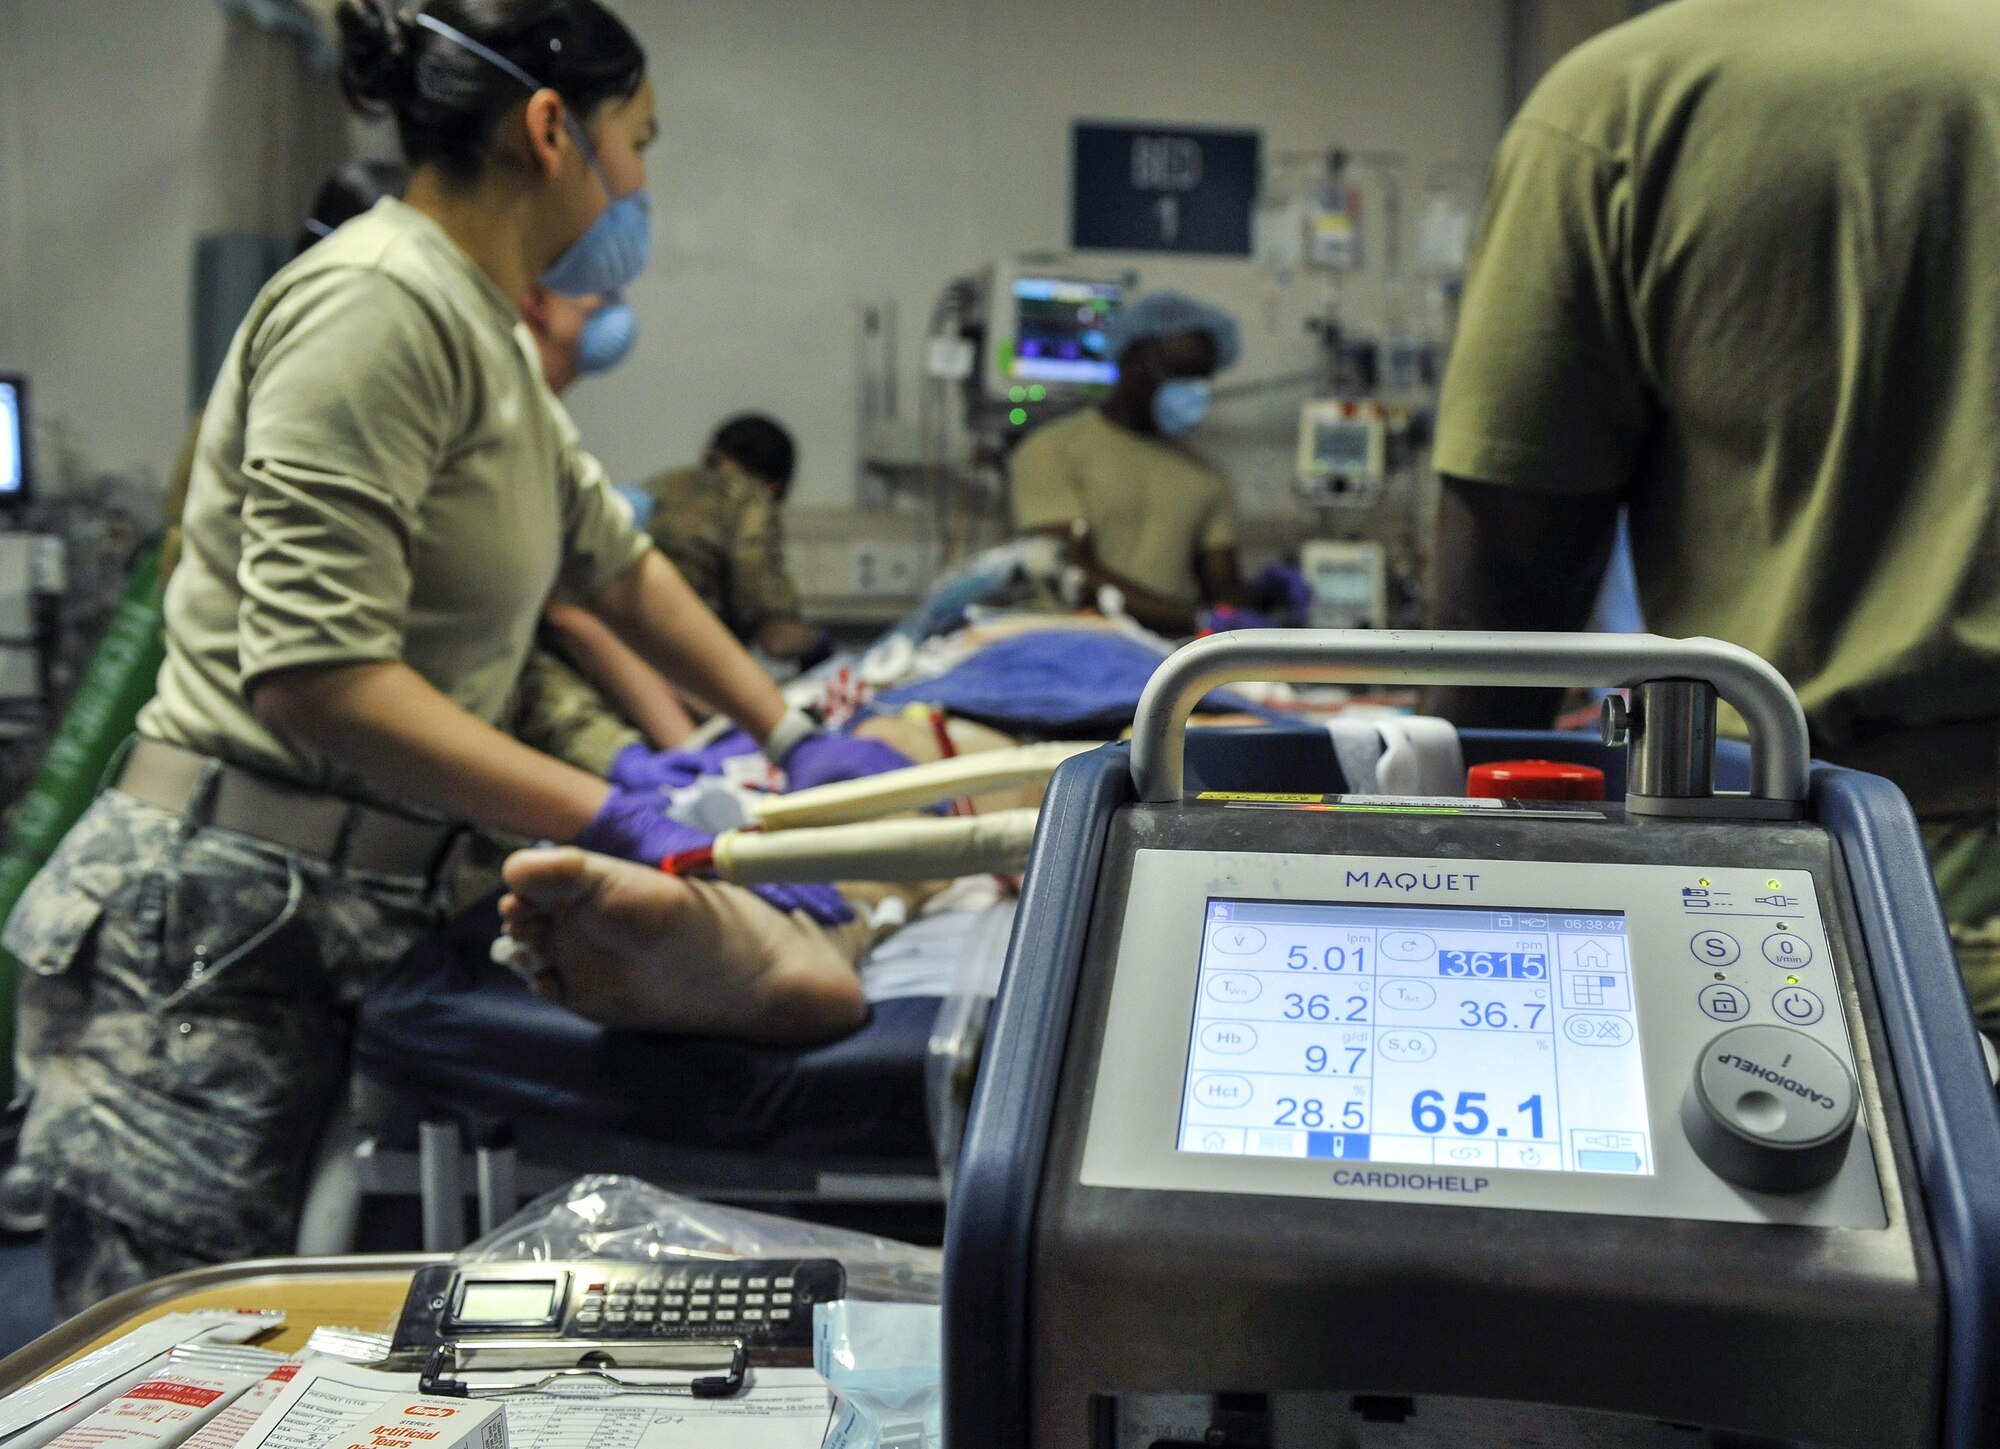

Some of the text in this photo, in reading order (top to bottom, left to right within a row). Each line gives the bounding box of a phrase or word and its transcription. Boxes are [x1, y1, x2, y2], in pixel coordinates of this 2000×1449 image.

[1346, 871, 1480, 892] MAQUET
[1564, 919, 1625, 931] 06:38:47
[1516, 940, 1543, 953] rpm
[1706, 938, 1727, 958] S
[1287, 945, 1364, 973] 5.01
[1446, 950, 1545, 980] 3615
[1283, 993, 1368, 1022] 36.2
[1460, 1000, 1546, 1030] 36.7
[1217, 1032, 1242, 1044] Hb
[1305, 1045, 1367, 1074] 9.7
[1208, 1085, 1238, 1098] Hct
[1717, 1053, 1836, 1110] CARDIOHELP
[1273, 1097, 1365, 1130] 28.5
[1411, 1089, 1544, 1139] 65.1
[1333, 1169, 1490, 1193] CARDIOHELP
[369, 1425, 441, 1441] Artificial
[399, 1419, 434, 1428] STERILE
[370, 1435, 413, 1449] Tears
